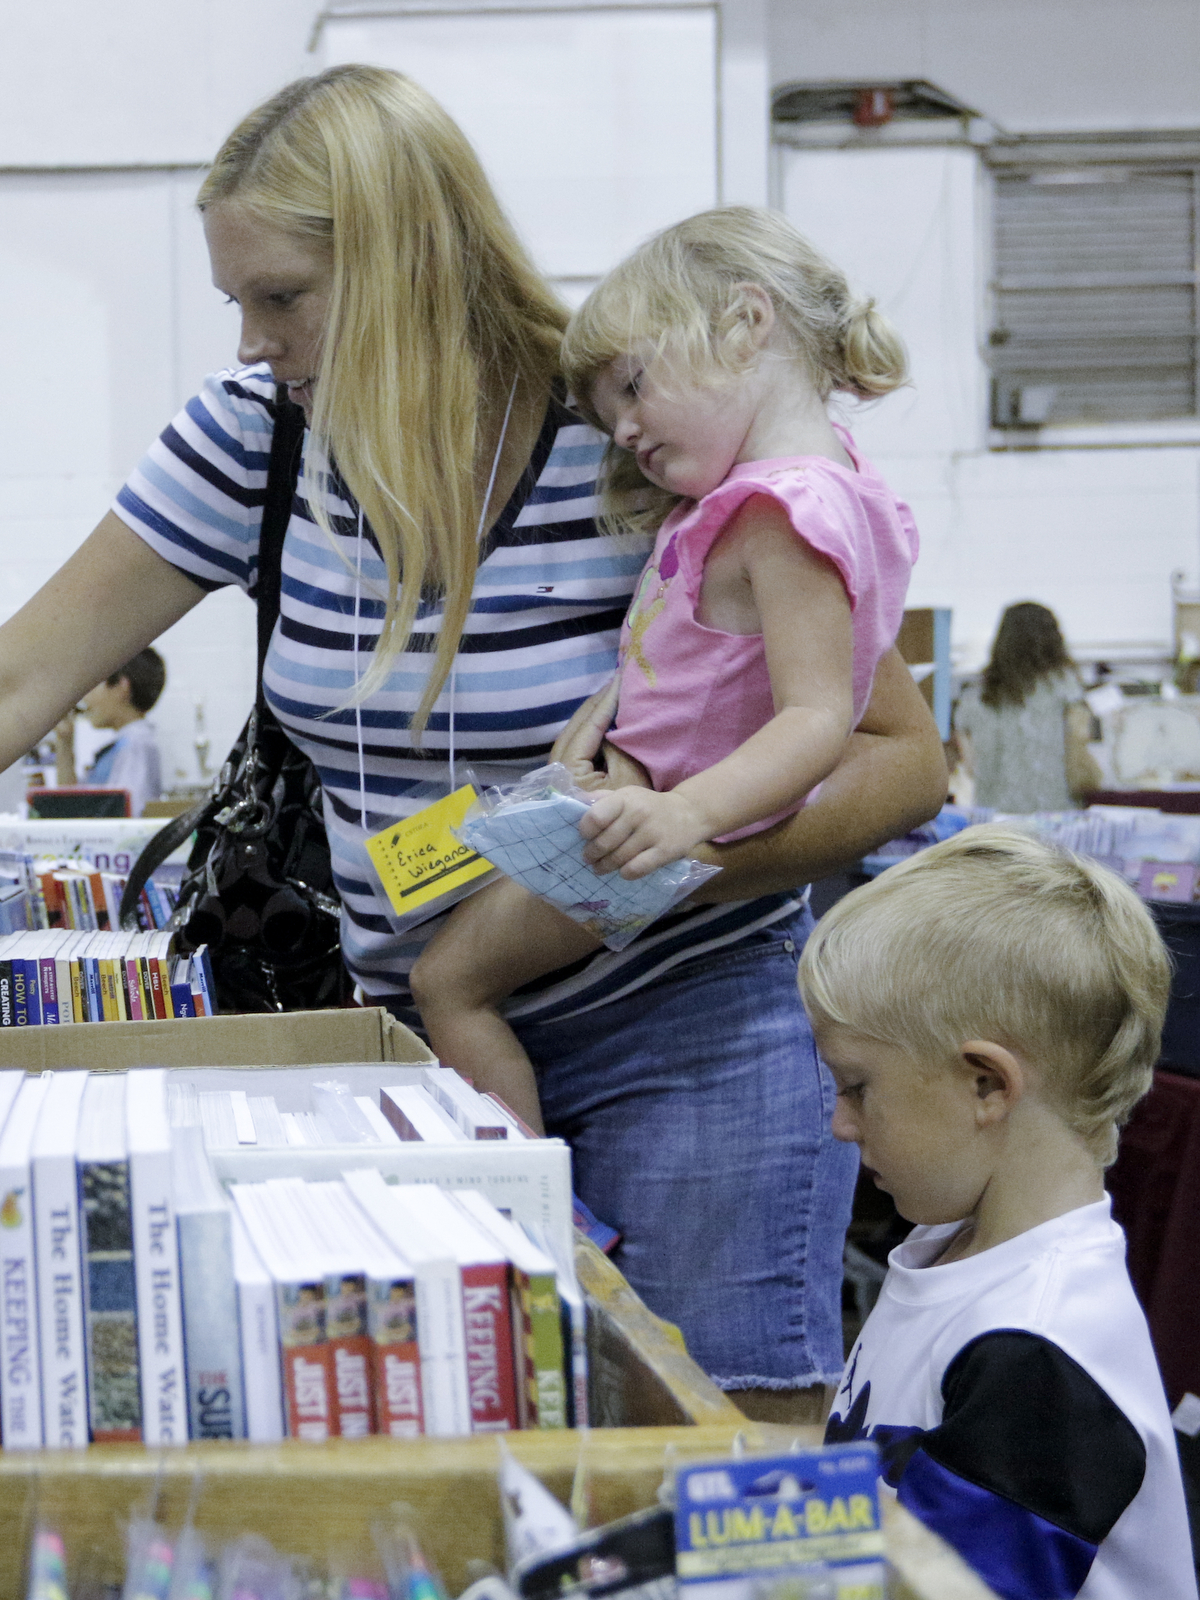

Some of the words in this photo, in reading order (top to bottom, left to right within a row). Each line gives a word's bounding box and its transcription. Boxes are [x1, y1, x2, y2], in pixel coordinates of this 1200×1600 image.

[397, 843, 438, 867] Erica
[0, 978, 11, 1026] CREATING
[14, 973, 26, 1004] HOW
[16, 1008, 27, 1025] TO
[50, 1202, 72, 1260] The
[148, 1198, 170, 1256] The
[3, 1256, 32, 1387] KEEPING
[53, 1271, 73, 1361] Home
[151, 1267, 172, 1356] Home
[464, 1286, 501, 1411] KEEPING
[689, 1494, 874, 1550] LUM-A-BAR
